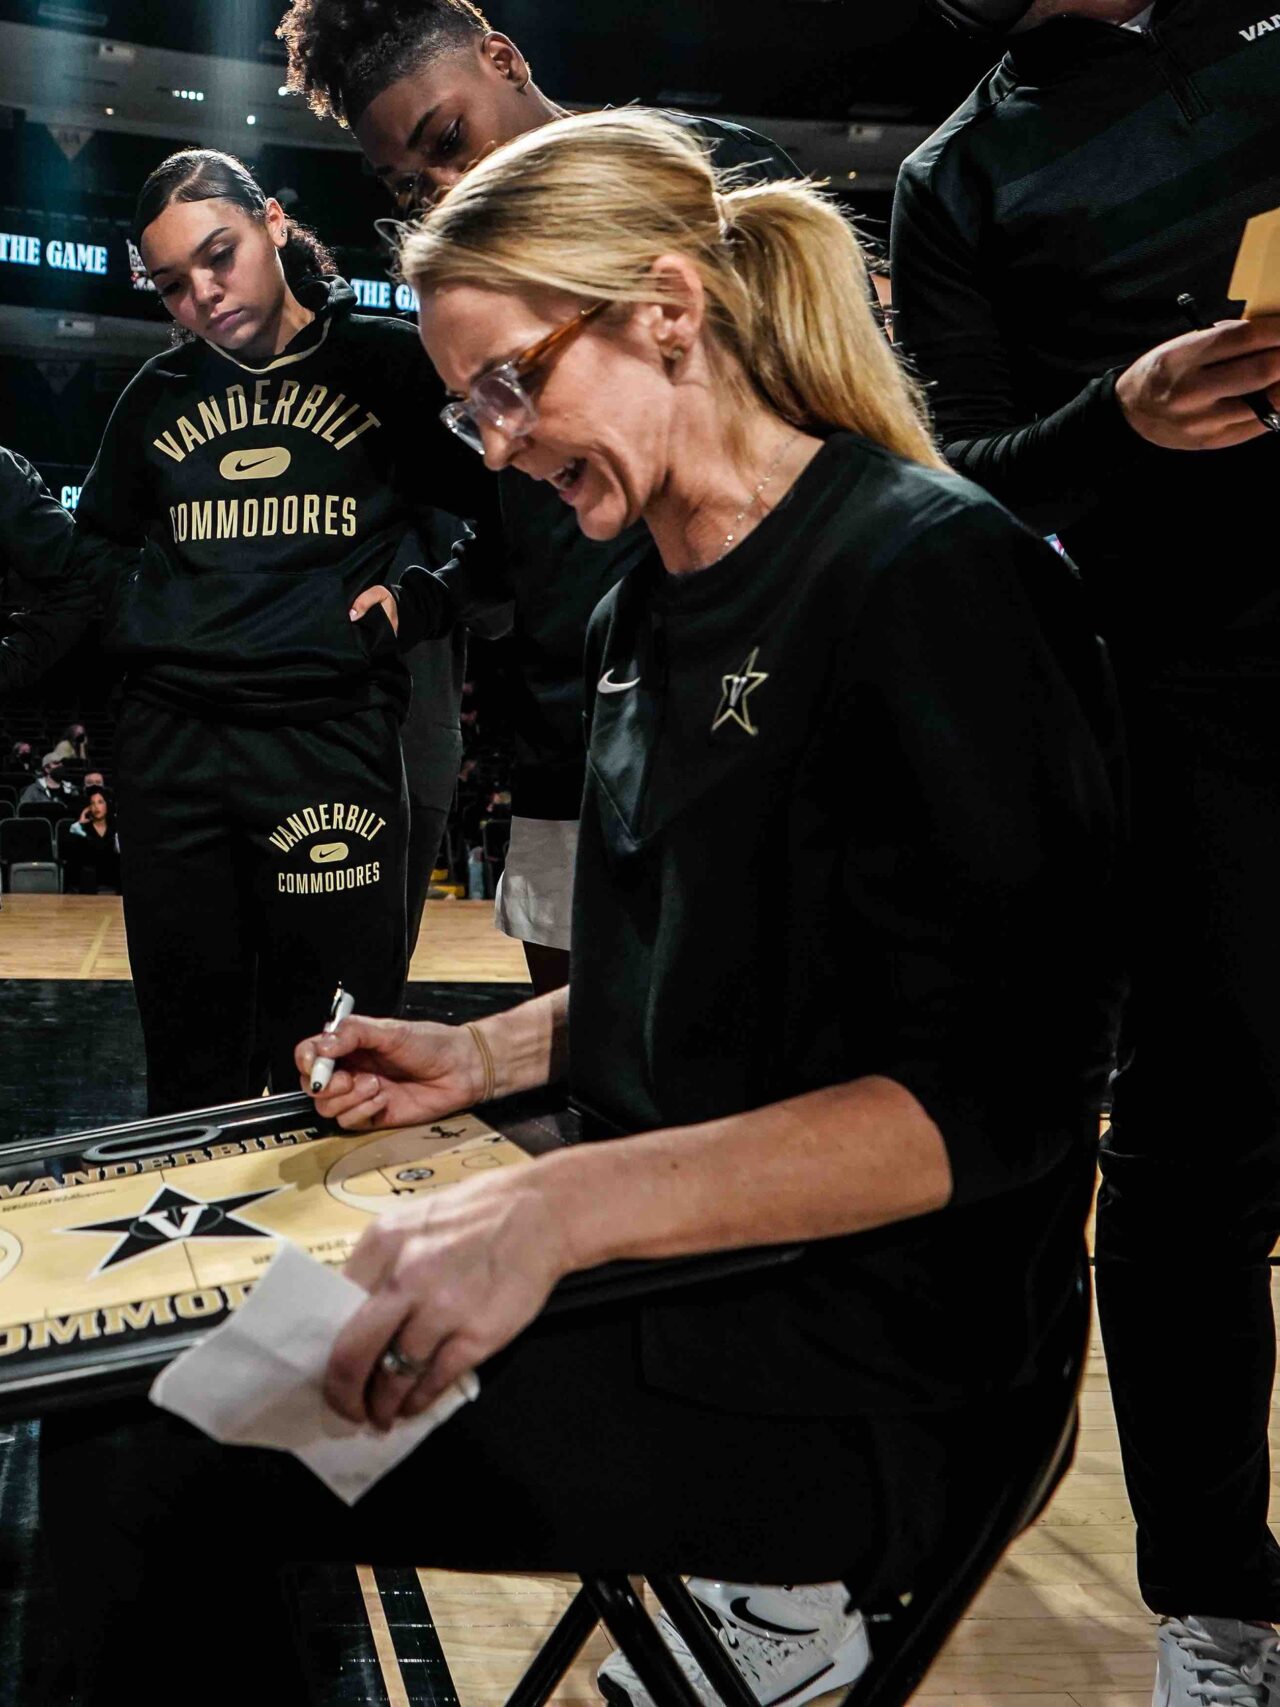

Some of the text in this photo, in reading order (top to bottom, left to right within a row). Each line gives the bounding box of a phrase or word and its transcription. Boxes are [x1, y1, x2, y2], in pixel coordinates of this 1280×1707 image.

[46, 240, 108, 275] GAME
[350, 278, 420, 312] THE GA
[153, 379, 382, 463] VANDERBILT
[269, 803, 387, 853] VANDERBILT
[278, 861, 380, 894] COMMODORES
[138, 1204, 209, 1240] V
